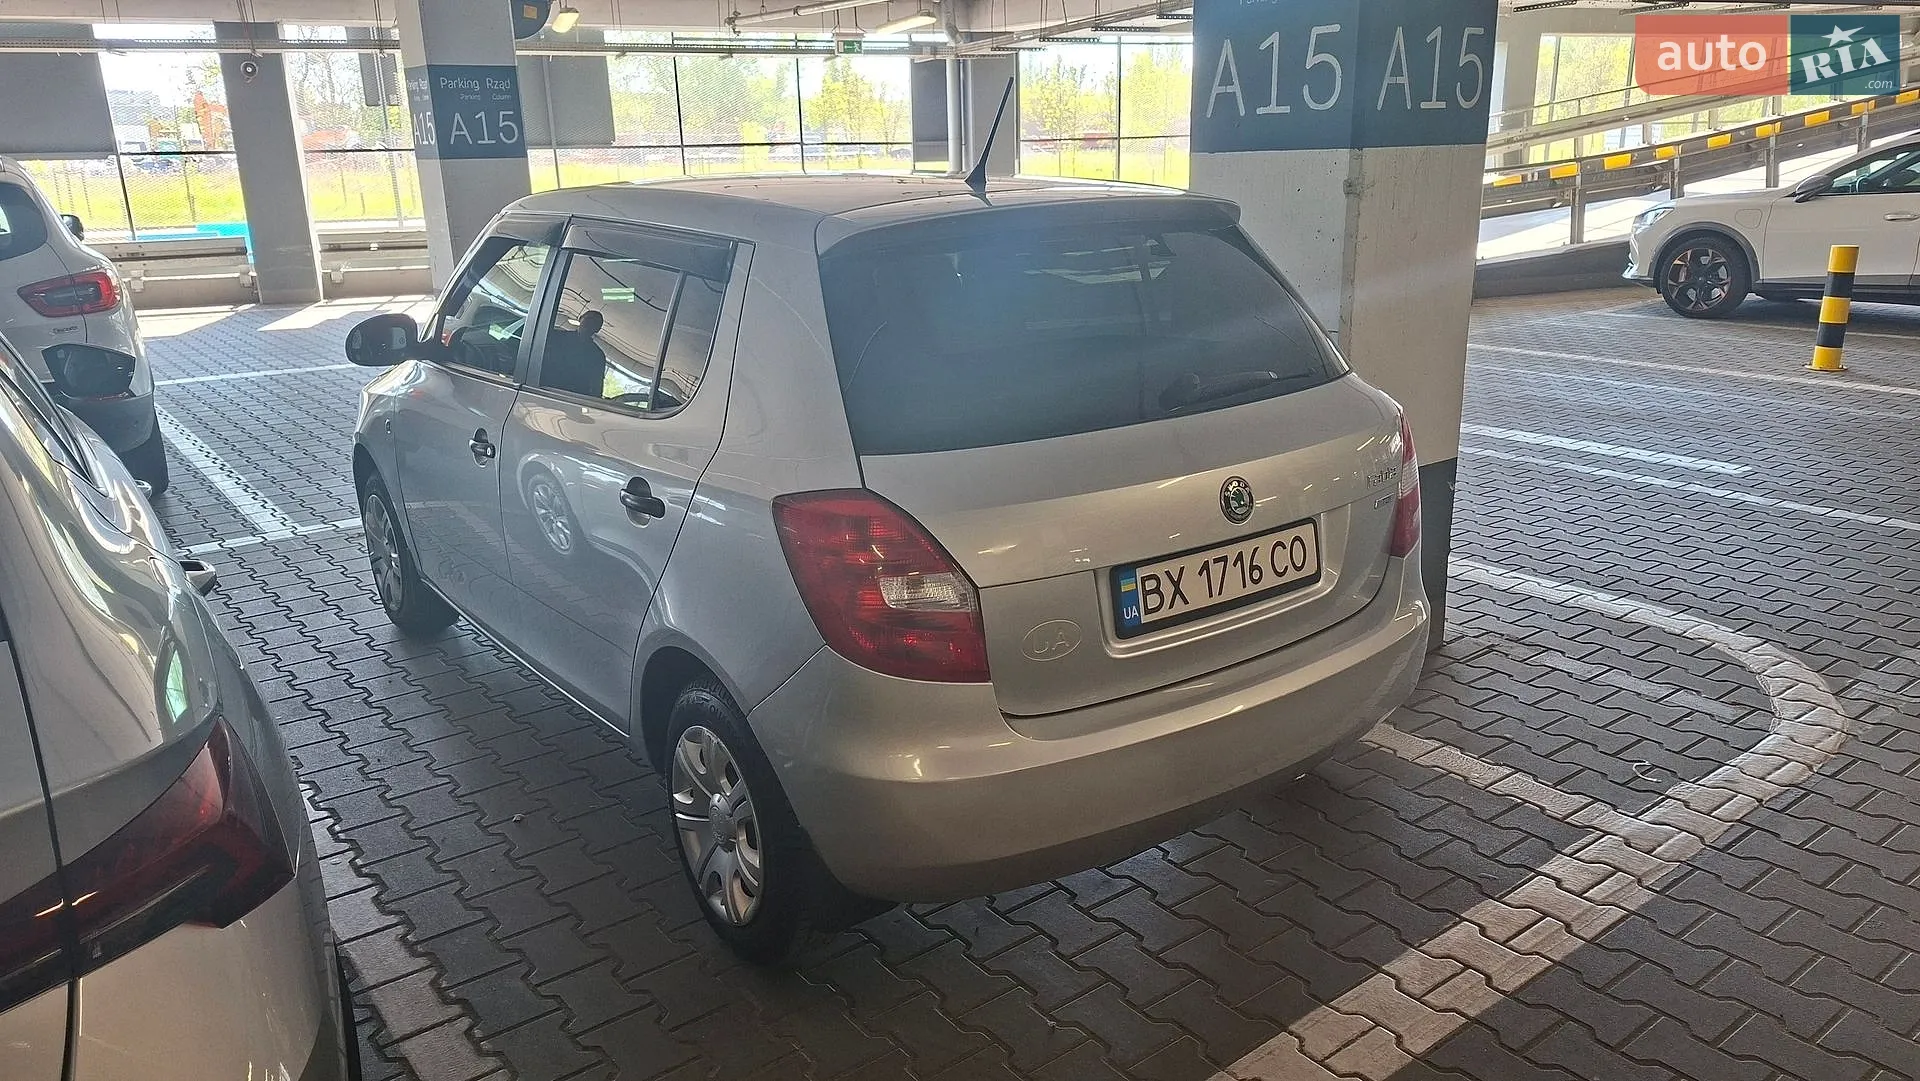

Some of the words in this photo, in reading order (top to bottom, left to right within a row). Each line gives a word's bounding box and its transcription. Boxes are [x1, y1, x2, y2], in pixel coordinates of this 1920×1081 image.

[440, 77, 480, 91] Parking
[486, 77, 511, 91] Rząd
[1206, 24, 1342, 118] A15
[1377, 25, 1485, 111] A15
[413, 112, 436, 145] A15
[450, 111, 519, 144] A15
[1140, 564, 1190, 616] BX
[1198, 546, 1264, 598] 1716
[1270, 535, 1307, 578] CO
[1123, 607, 1139, 620] UA
